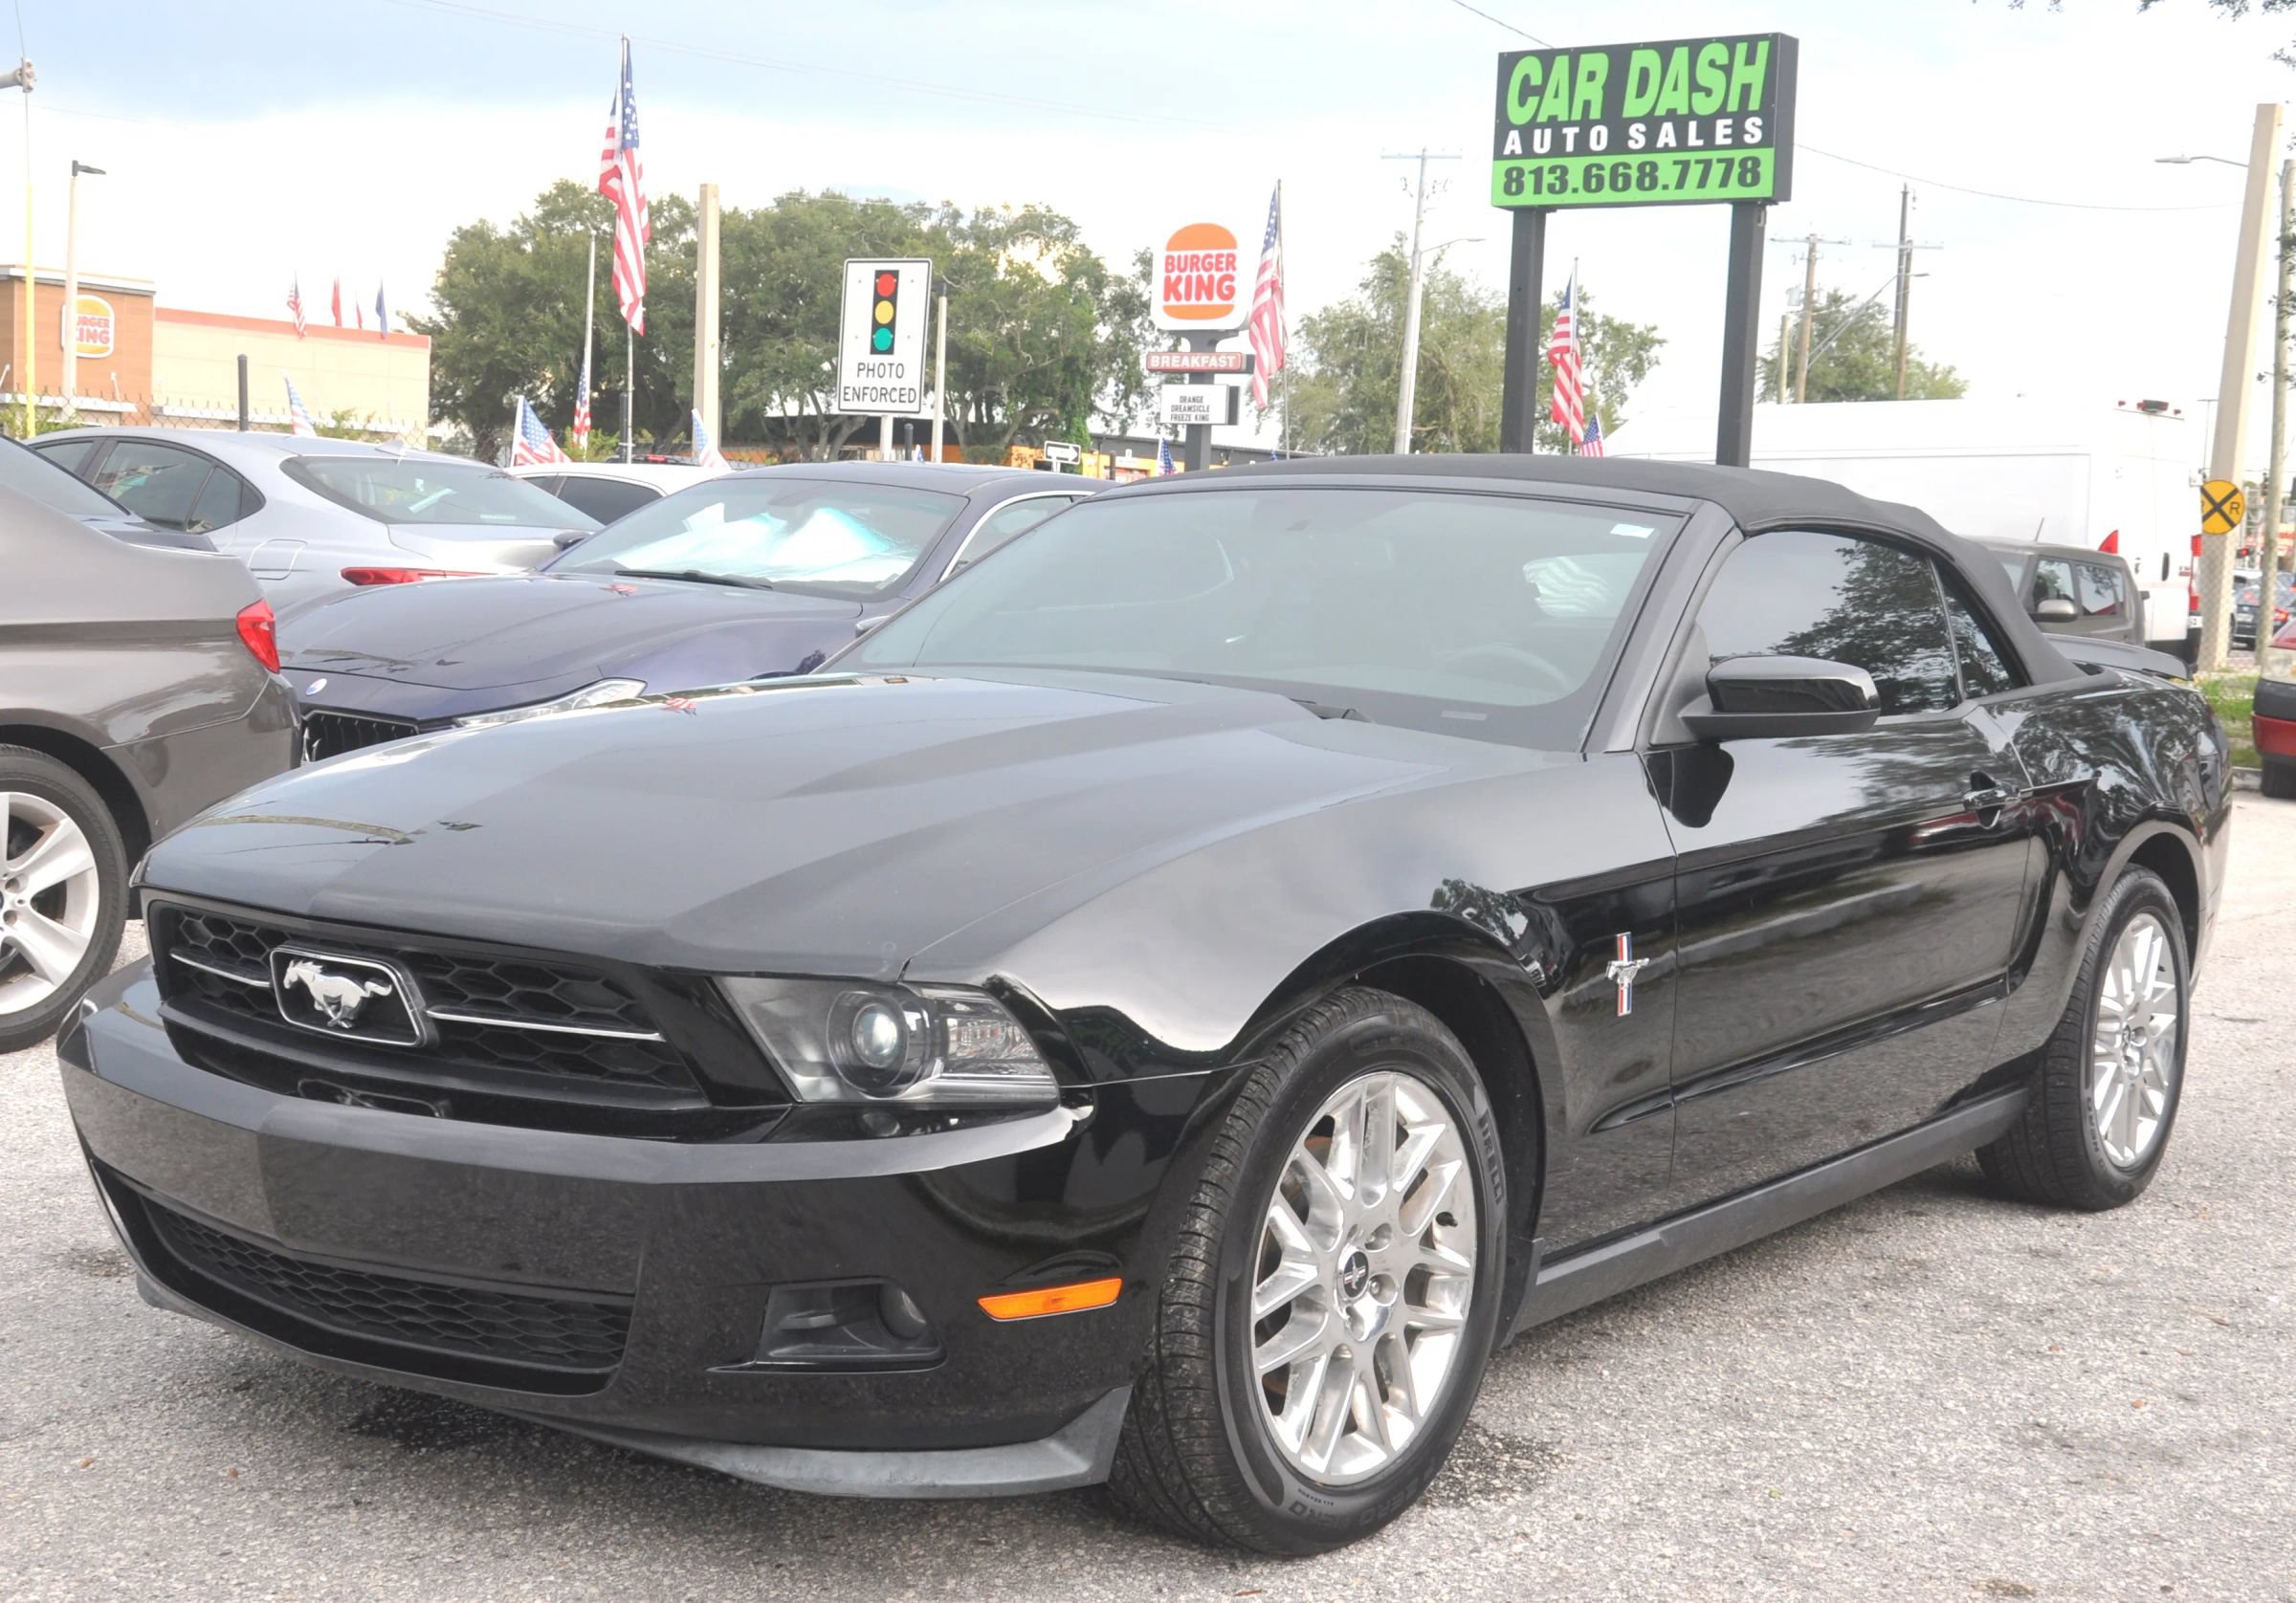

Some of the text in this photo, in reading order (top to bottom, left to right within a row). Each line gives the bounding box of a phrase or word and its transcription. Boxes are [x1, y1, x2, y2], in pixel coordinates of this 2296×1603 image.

[1507, 41, 1770, 125] CAR DASH
[1503, 117, 1763, 155] AUTO SALES
[1503, 156, 1761, 197] 813.668.7778
[1164, 253, 1237, 274] BURGER
[1163, 274, 1236, 302] KING
[77, 327, 110, 344] ING
[857, 362, 905, 379] PHOTO
[1151, 355, 1237, 368] BREAKFAST
[843, 386, 916, 404] ENFORCED
